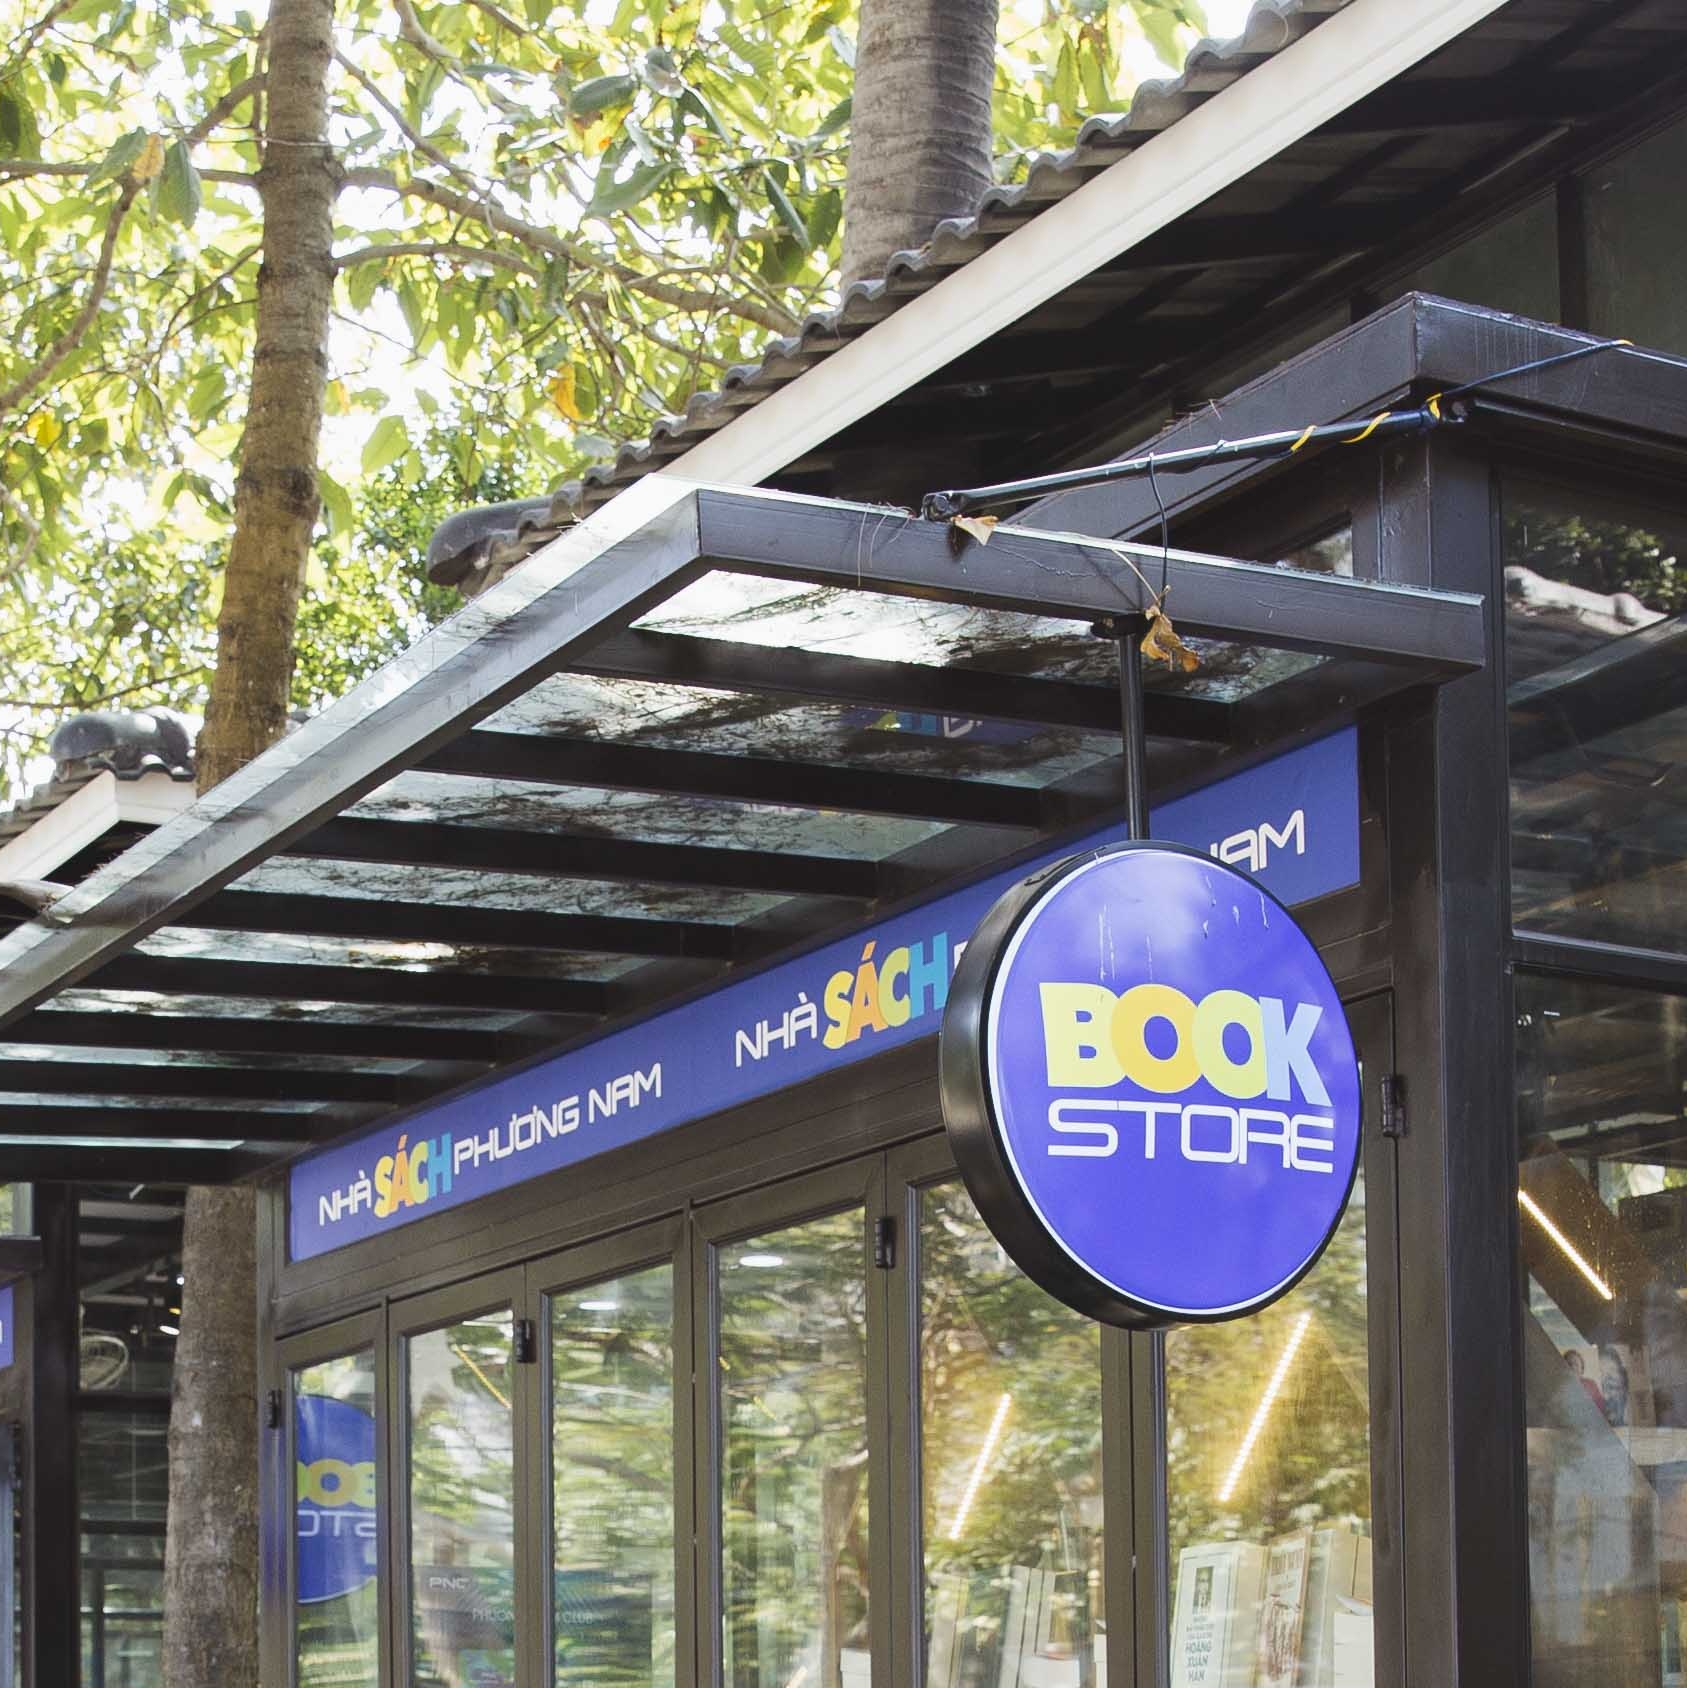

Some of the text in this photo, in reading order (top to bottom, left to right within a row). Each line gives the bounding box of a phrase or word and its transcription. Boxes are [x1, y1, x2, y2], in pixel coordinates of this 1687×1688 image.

[735, 991, 817, 1067] NHÀ
[822, 932, 949, 1050] SÁCH
[1210, 809, 1305, 872] AM
[1039, 982, 1332, 1107] BOOK
[318, 1062, 662, 1226] NHÀ SÁCH PHƯƠNG NAM
[1047, 1098, 1334, 1174] STORE
